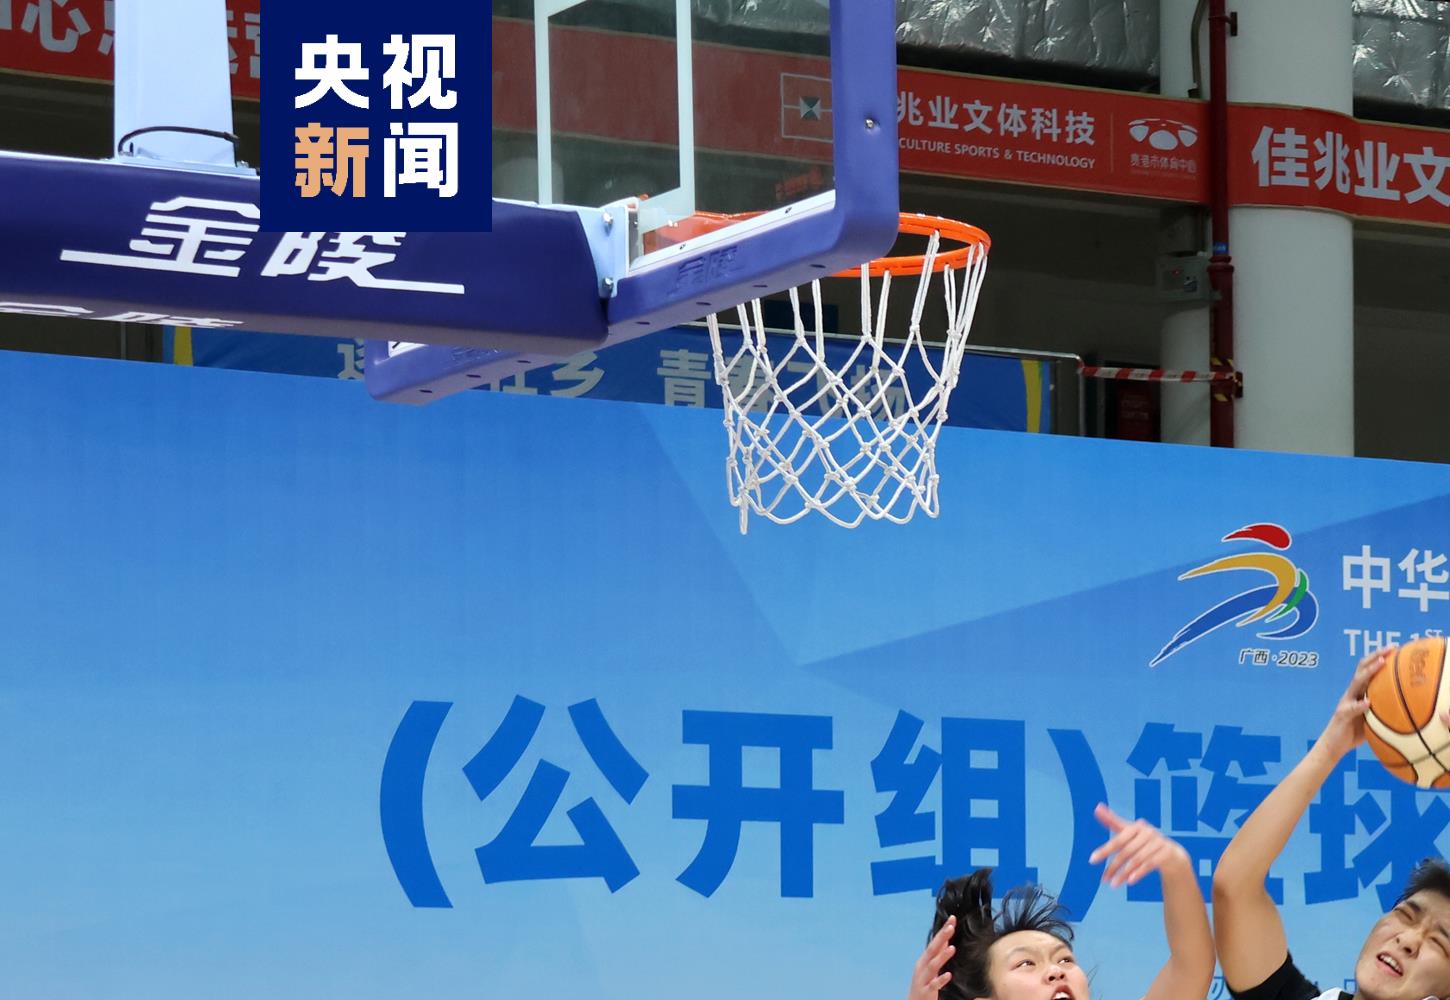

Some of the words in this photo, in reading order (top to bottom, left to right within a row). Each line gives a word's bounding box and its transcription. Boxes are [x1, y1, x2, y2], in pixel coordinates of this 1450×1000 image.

[896, 91, 1095, 145] 兆业文体科技
[899, 137, 950, 154] CULTURE
[954, 144, 999, 159] SPORTS
[1004, 150, 1013, 160] &
[1016, 150, 1095, 169] TECHNOLOGY
[60, 196, 465, 294] 金陵
